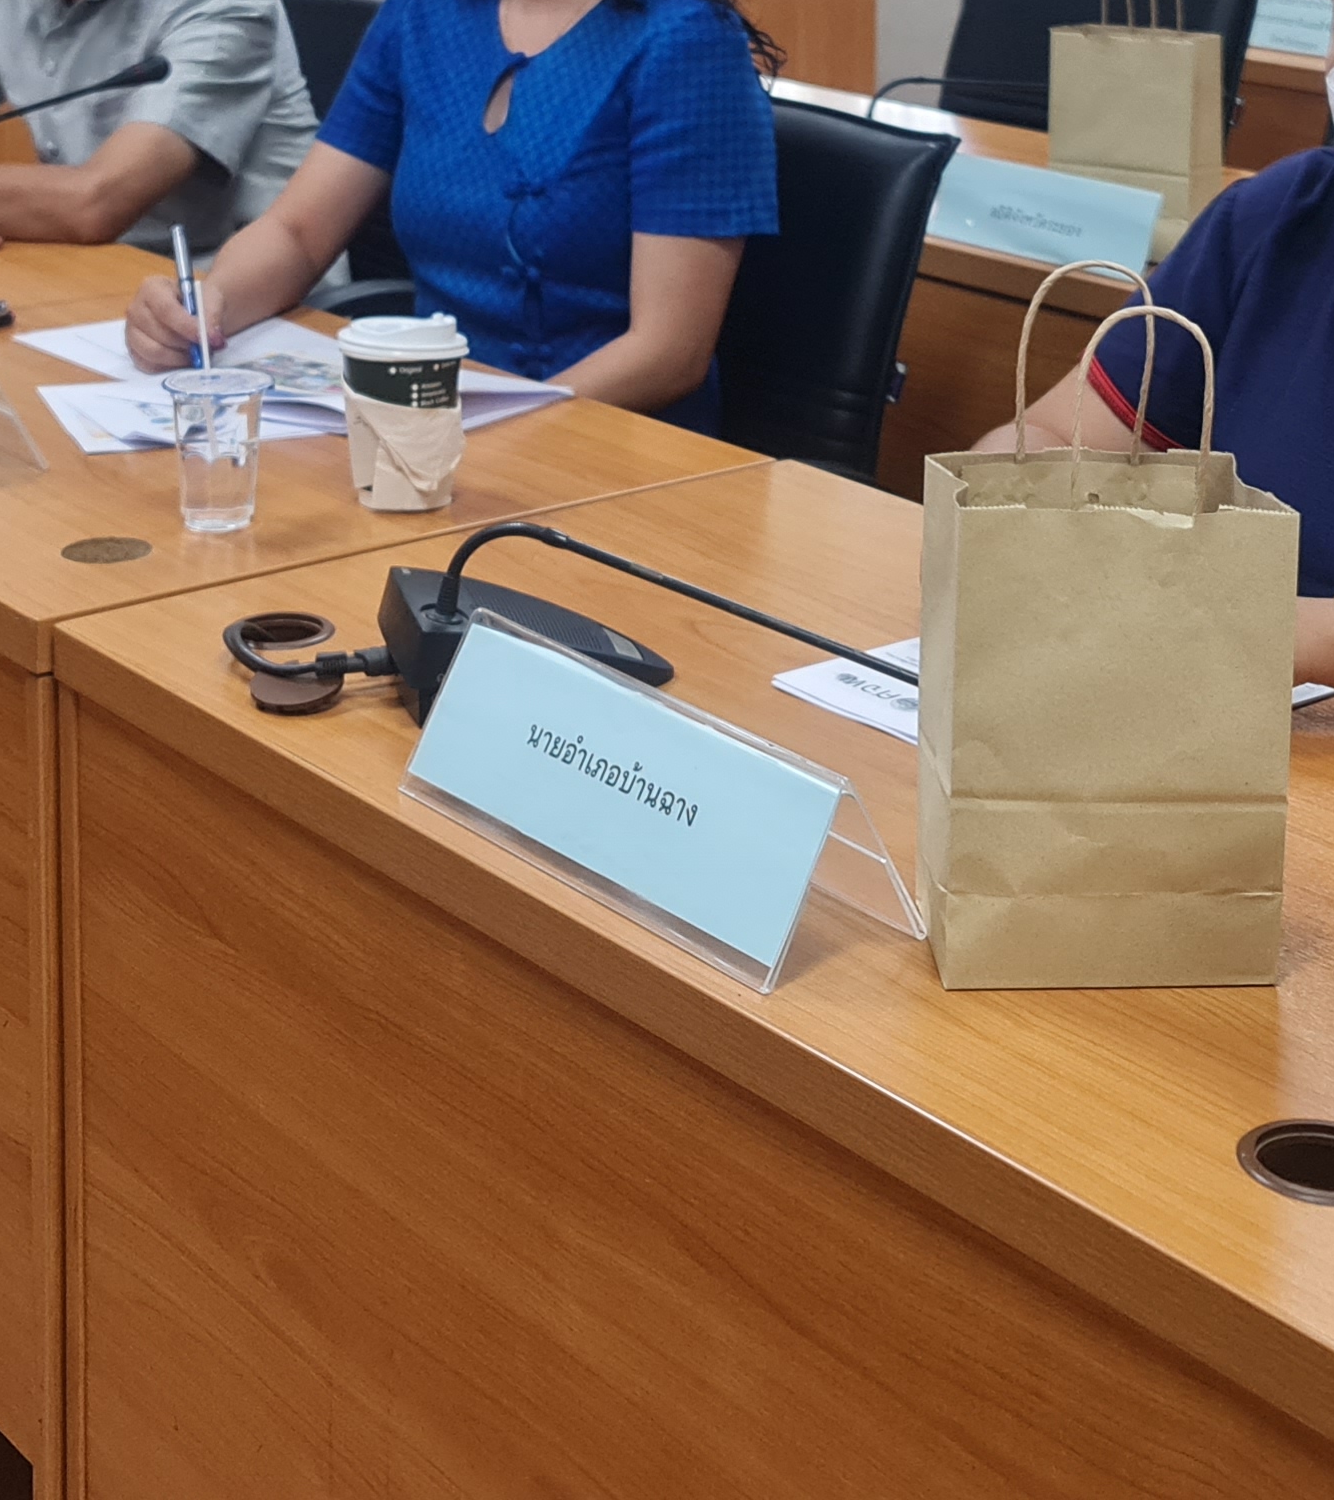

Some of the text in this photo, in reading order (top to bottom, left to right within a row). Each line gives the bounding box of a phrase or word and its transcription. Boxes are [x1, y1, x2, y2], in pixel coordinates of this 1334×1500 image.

[525, 720, 700, 828] นายอำเภอบ้านฉาง
